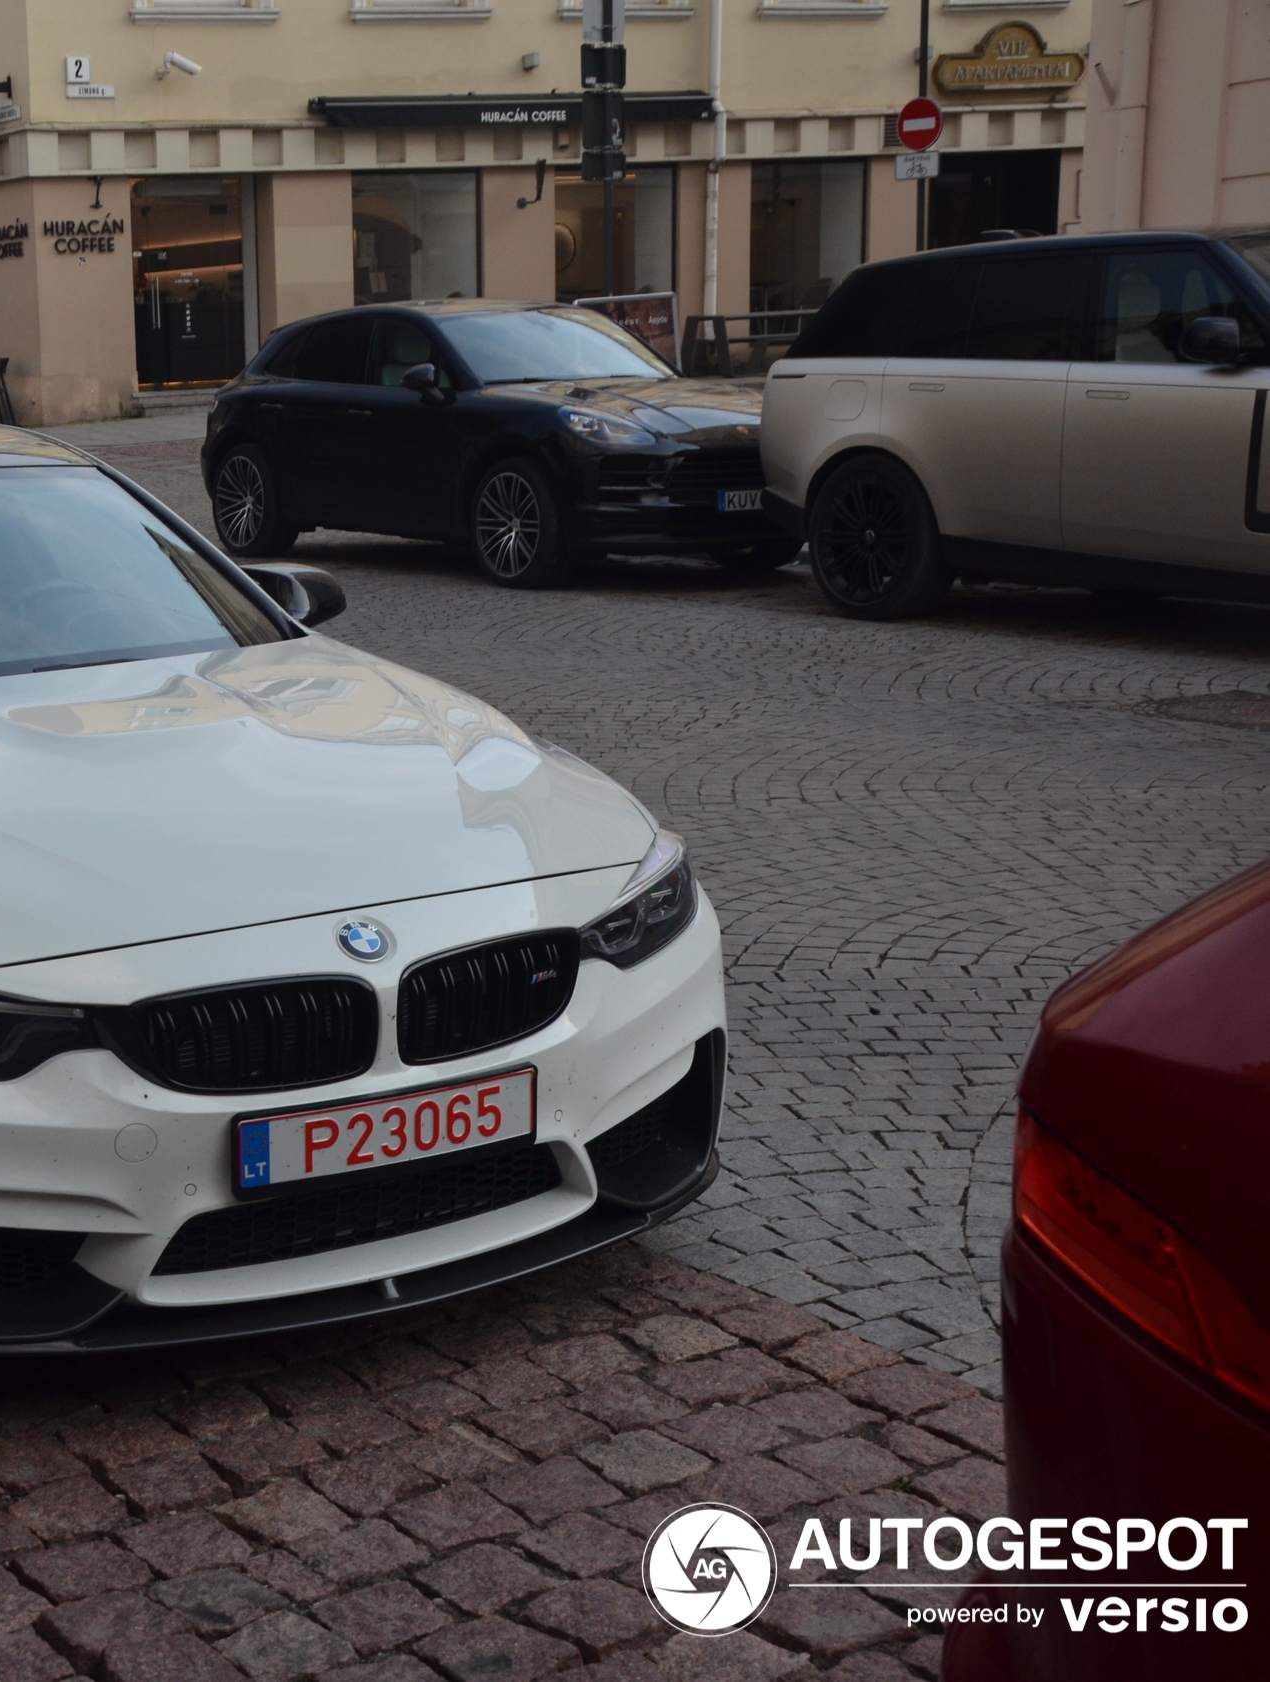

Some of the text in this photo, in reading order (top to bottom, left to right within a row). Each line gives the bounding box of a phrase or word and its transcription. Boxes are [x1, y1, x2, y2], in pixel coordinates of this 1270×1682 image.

[999, 40, 1029, 55] VIP
[74, 59, 83, 78] 2
[954, 62, 1071, 81] APARTAMENTAI
[480, 107, 567, 122] HURACÁN COFFEE
[43, 213, 124, 236] HURACÁN
[54, 236, 115, 254] COFFEE
[244, 1085, 502, 1179] LT P23065
